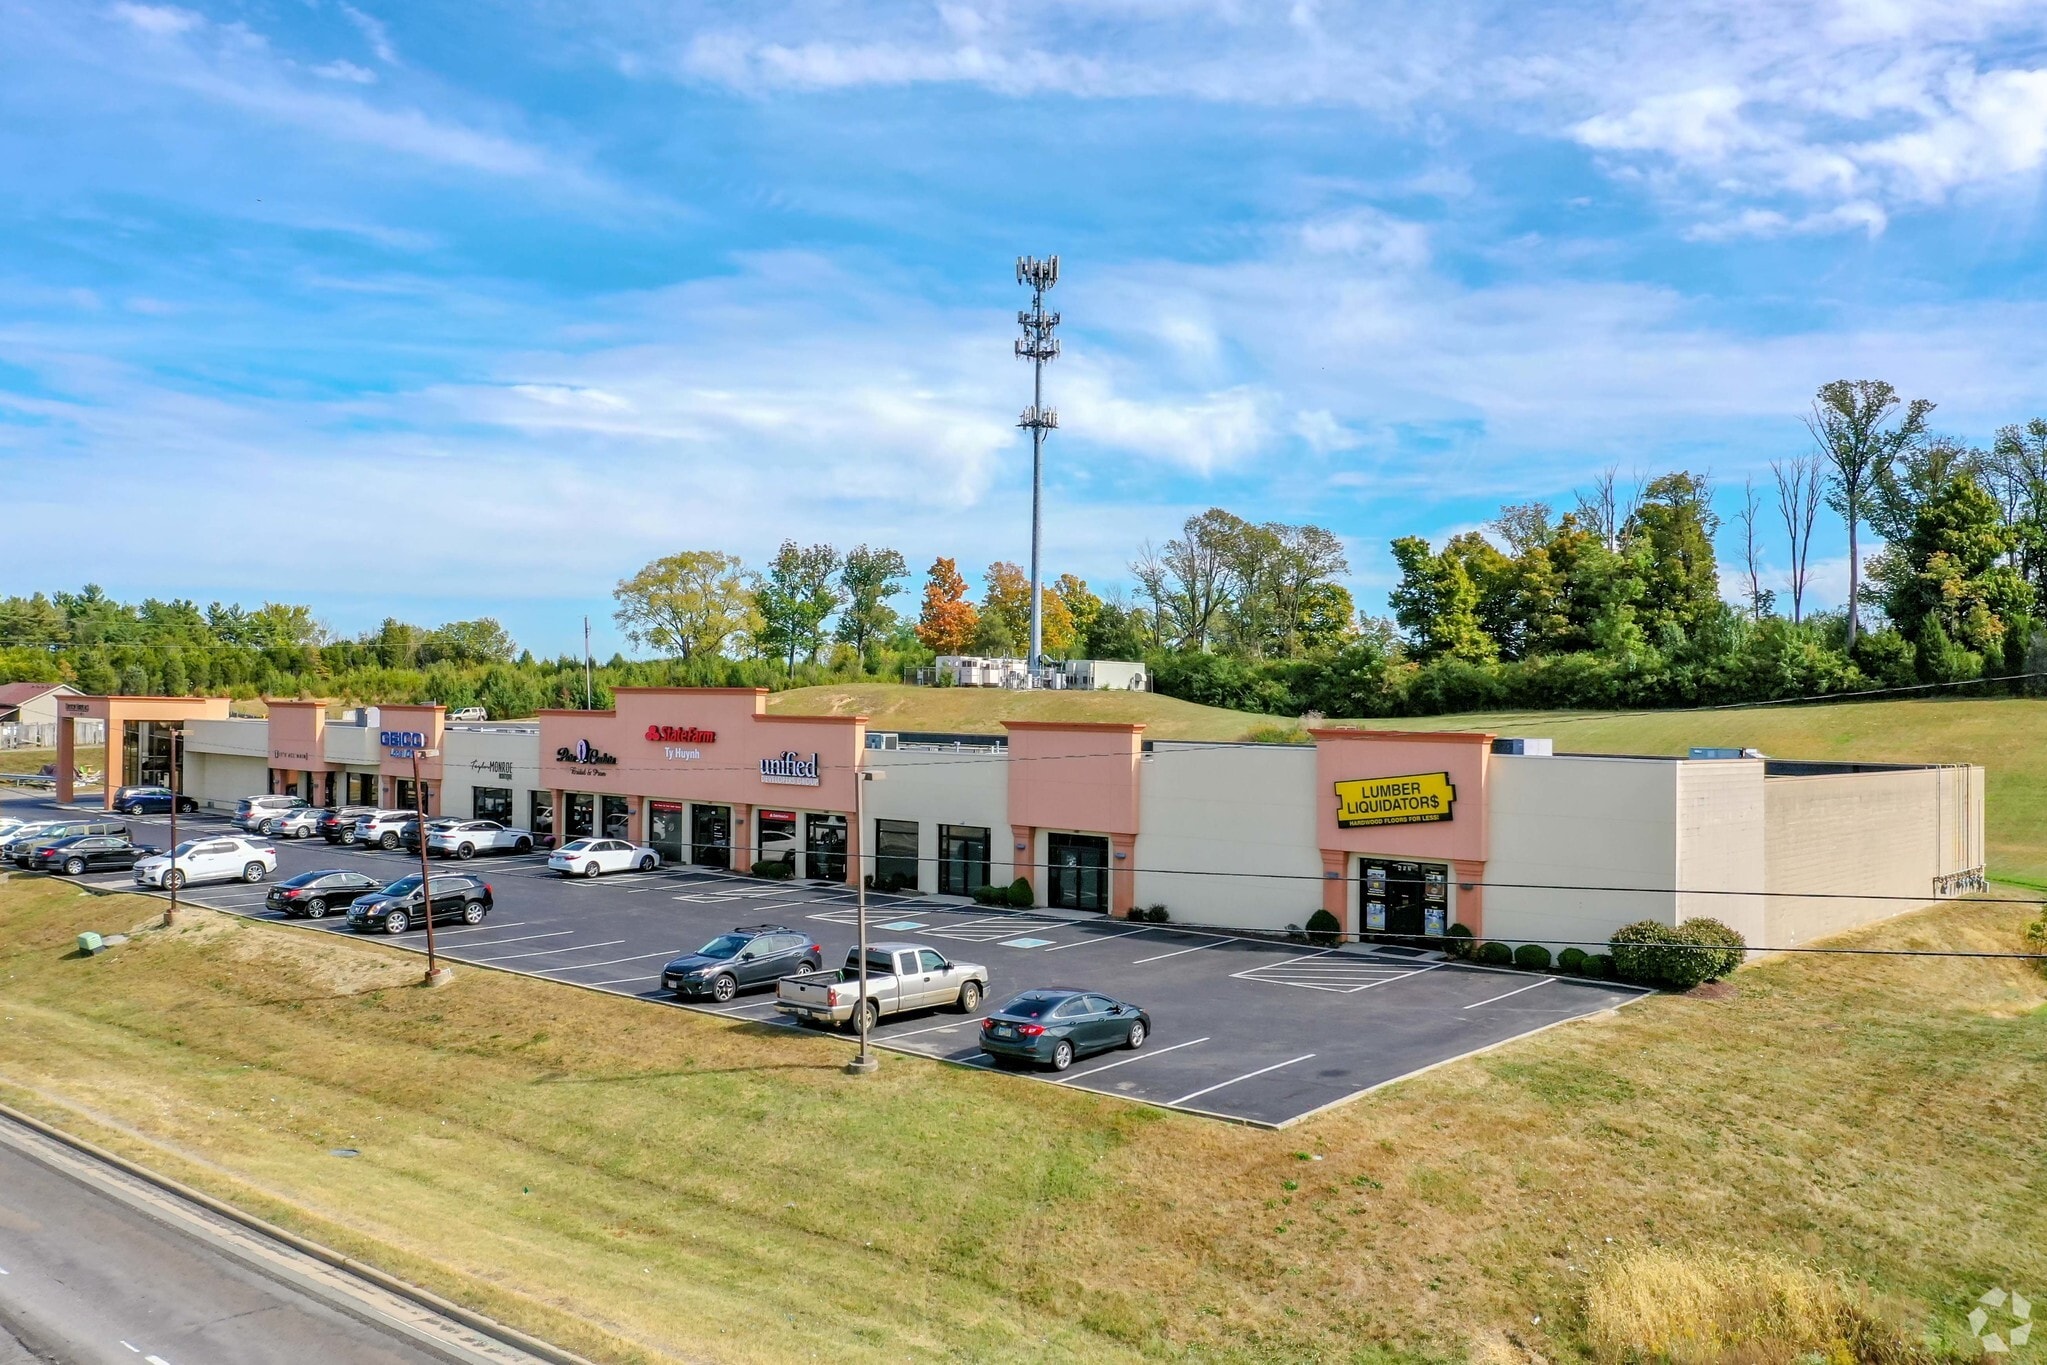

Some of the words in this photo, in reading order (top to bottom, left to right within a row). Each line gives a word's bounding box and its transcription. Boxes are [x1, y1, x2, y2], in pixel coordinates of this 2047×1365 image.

[380, 731, 425, 747] GEICO
[664, 747, 674, 760] Ty
[675, 748, 700, 760] Huynh
[490, 761, 512, 773] MONROE
[759, 751, 818, 778] unified
[1361, 782, 1421, 799] LUMBER
[1349, 818, 1383, 827] HARDWOOD
[1384, 816, 1408, 825] FLOORS
